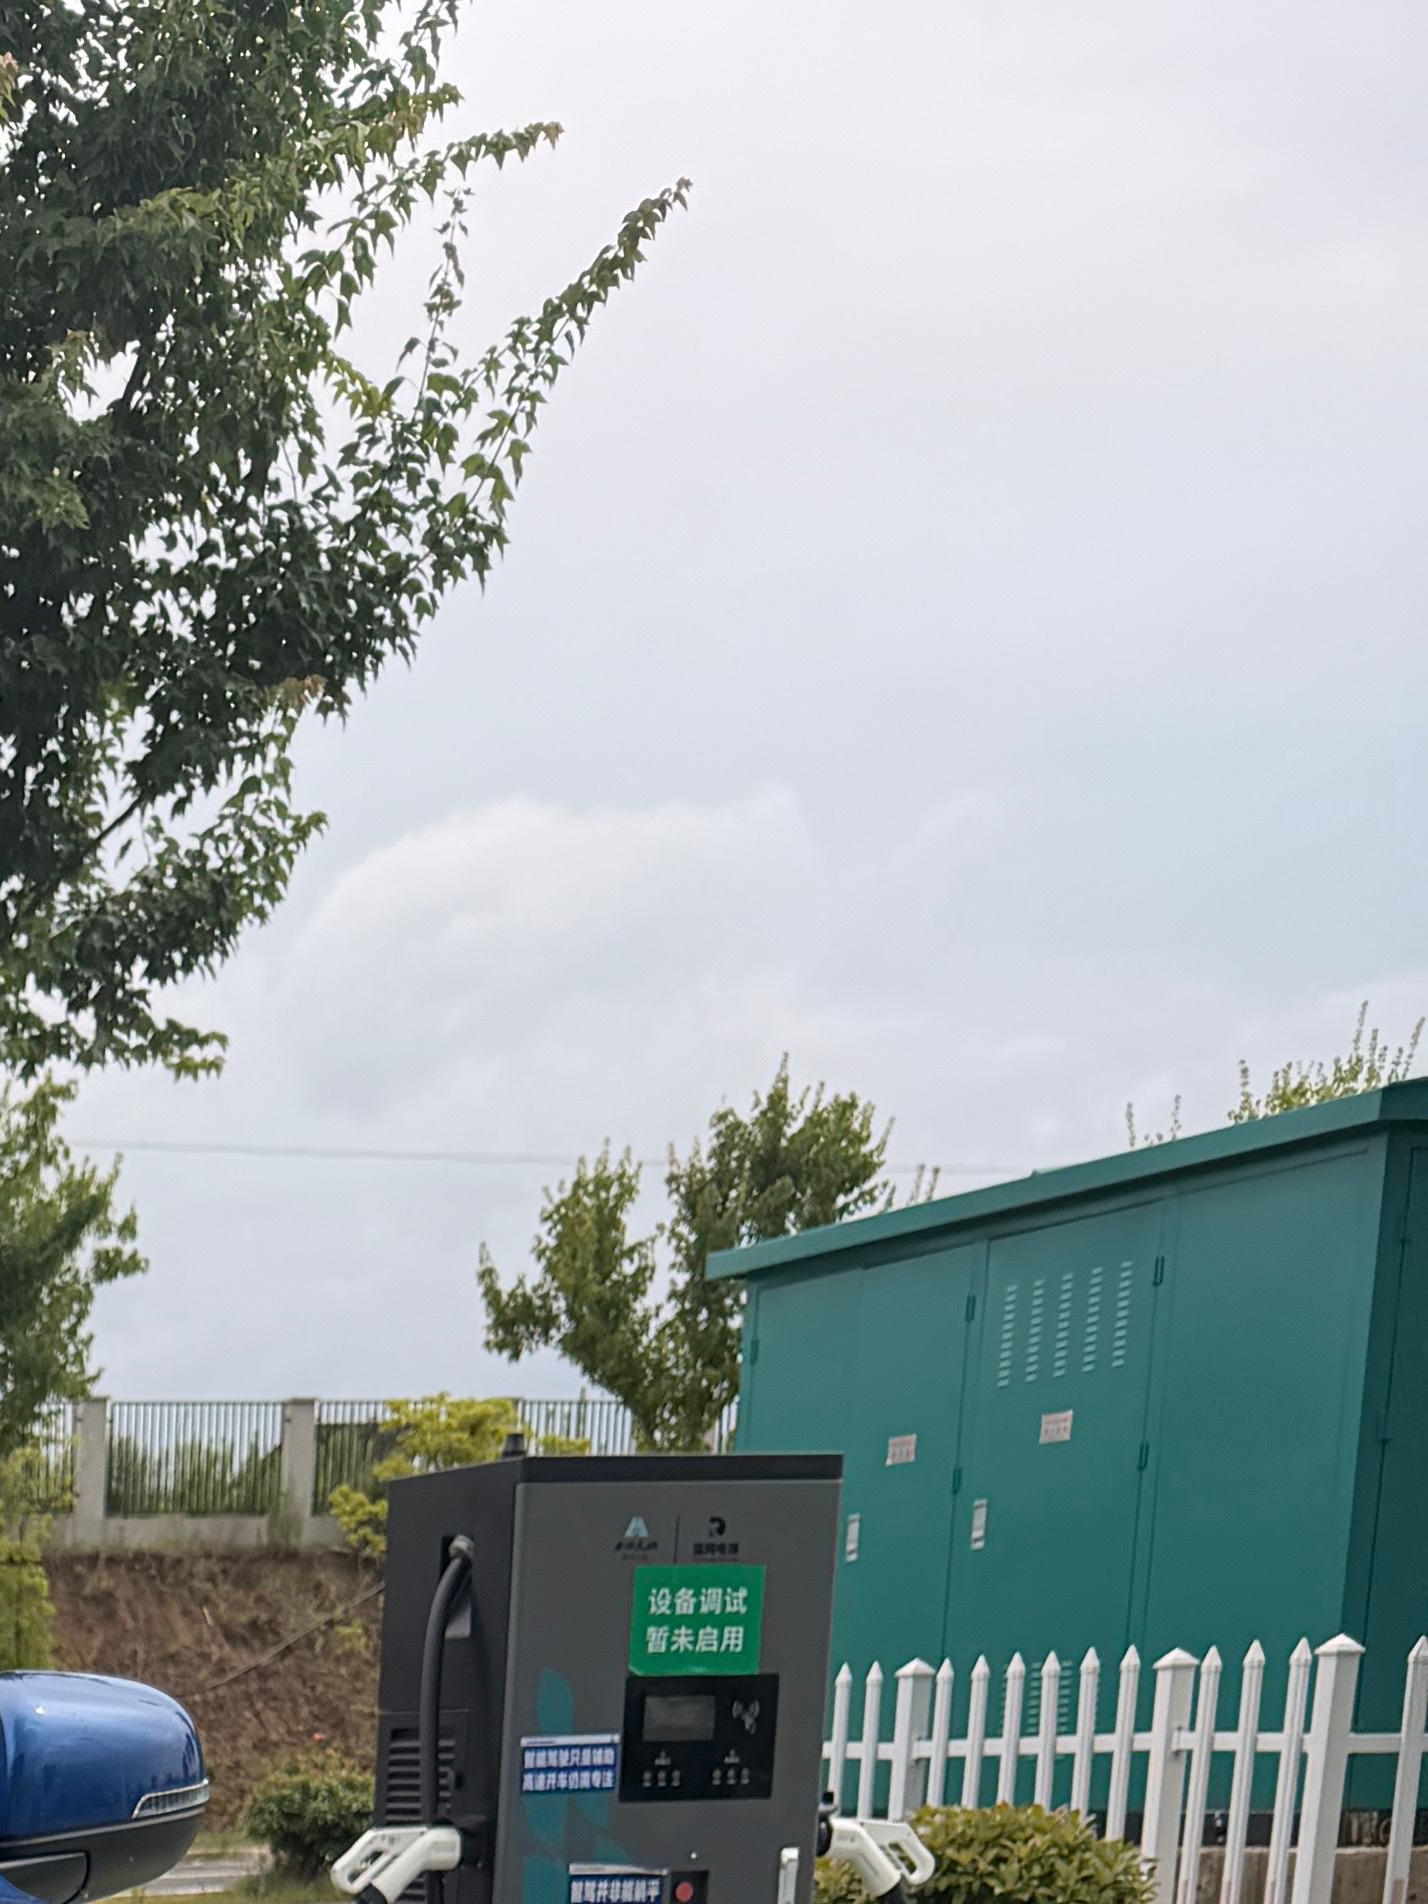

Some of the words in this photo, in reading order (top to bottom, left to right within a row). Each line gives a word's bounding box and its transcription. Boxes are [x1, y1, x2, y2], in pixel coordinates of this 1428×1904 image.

[648, 1586, 749, 1616] 设备调试
[645, 1625, 745, 1654] 暂未启用
